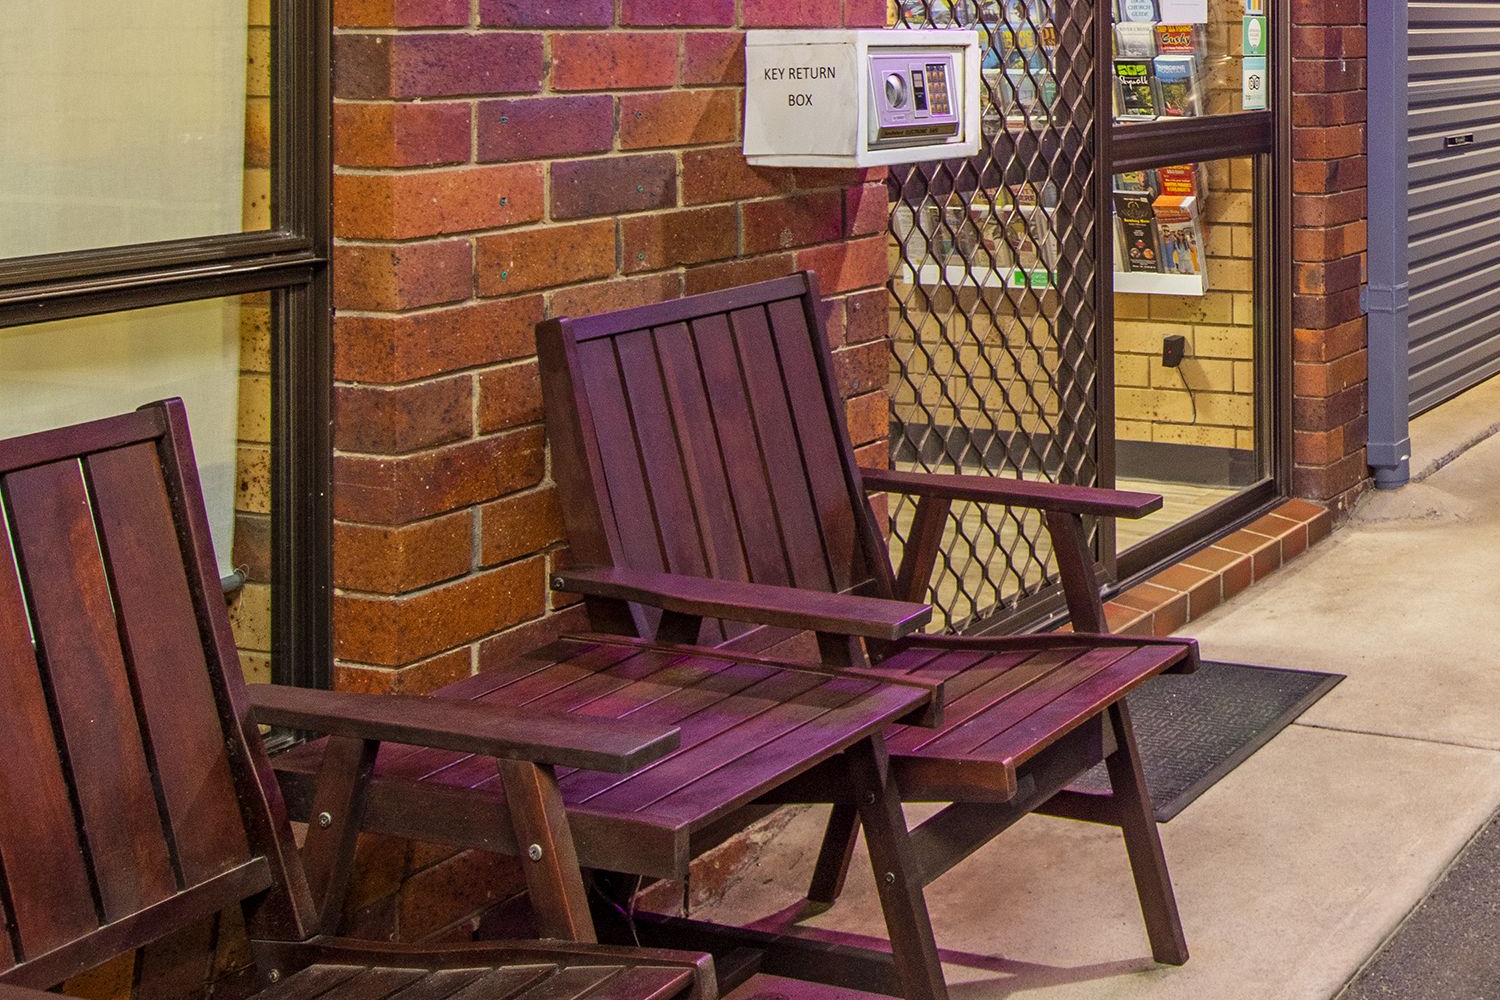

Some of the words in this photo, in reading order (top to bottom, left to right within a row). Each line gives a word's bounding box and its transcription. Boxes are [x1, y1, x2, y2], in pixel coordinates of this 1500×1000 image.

[764, 67, 785, 81] KEY
[788, 66, 836, 80] RETURN
[788, 93, 813, 107] BOX
